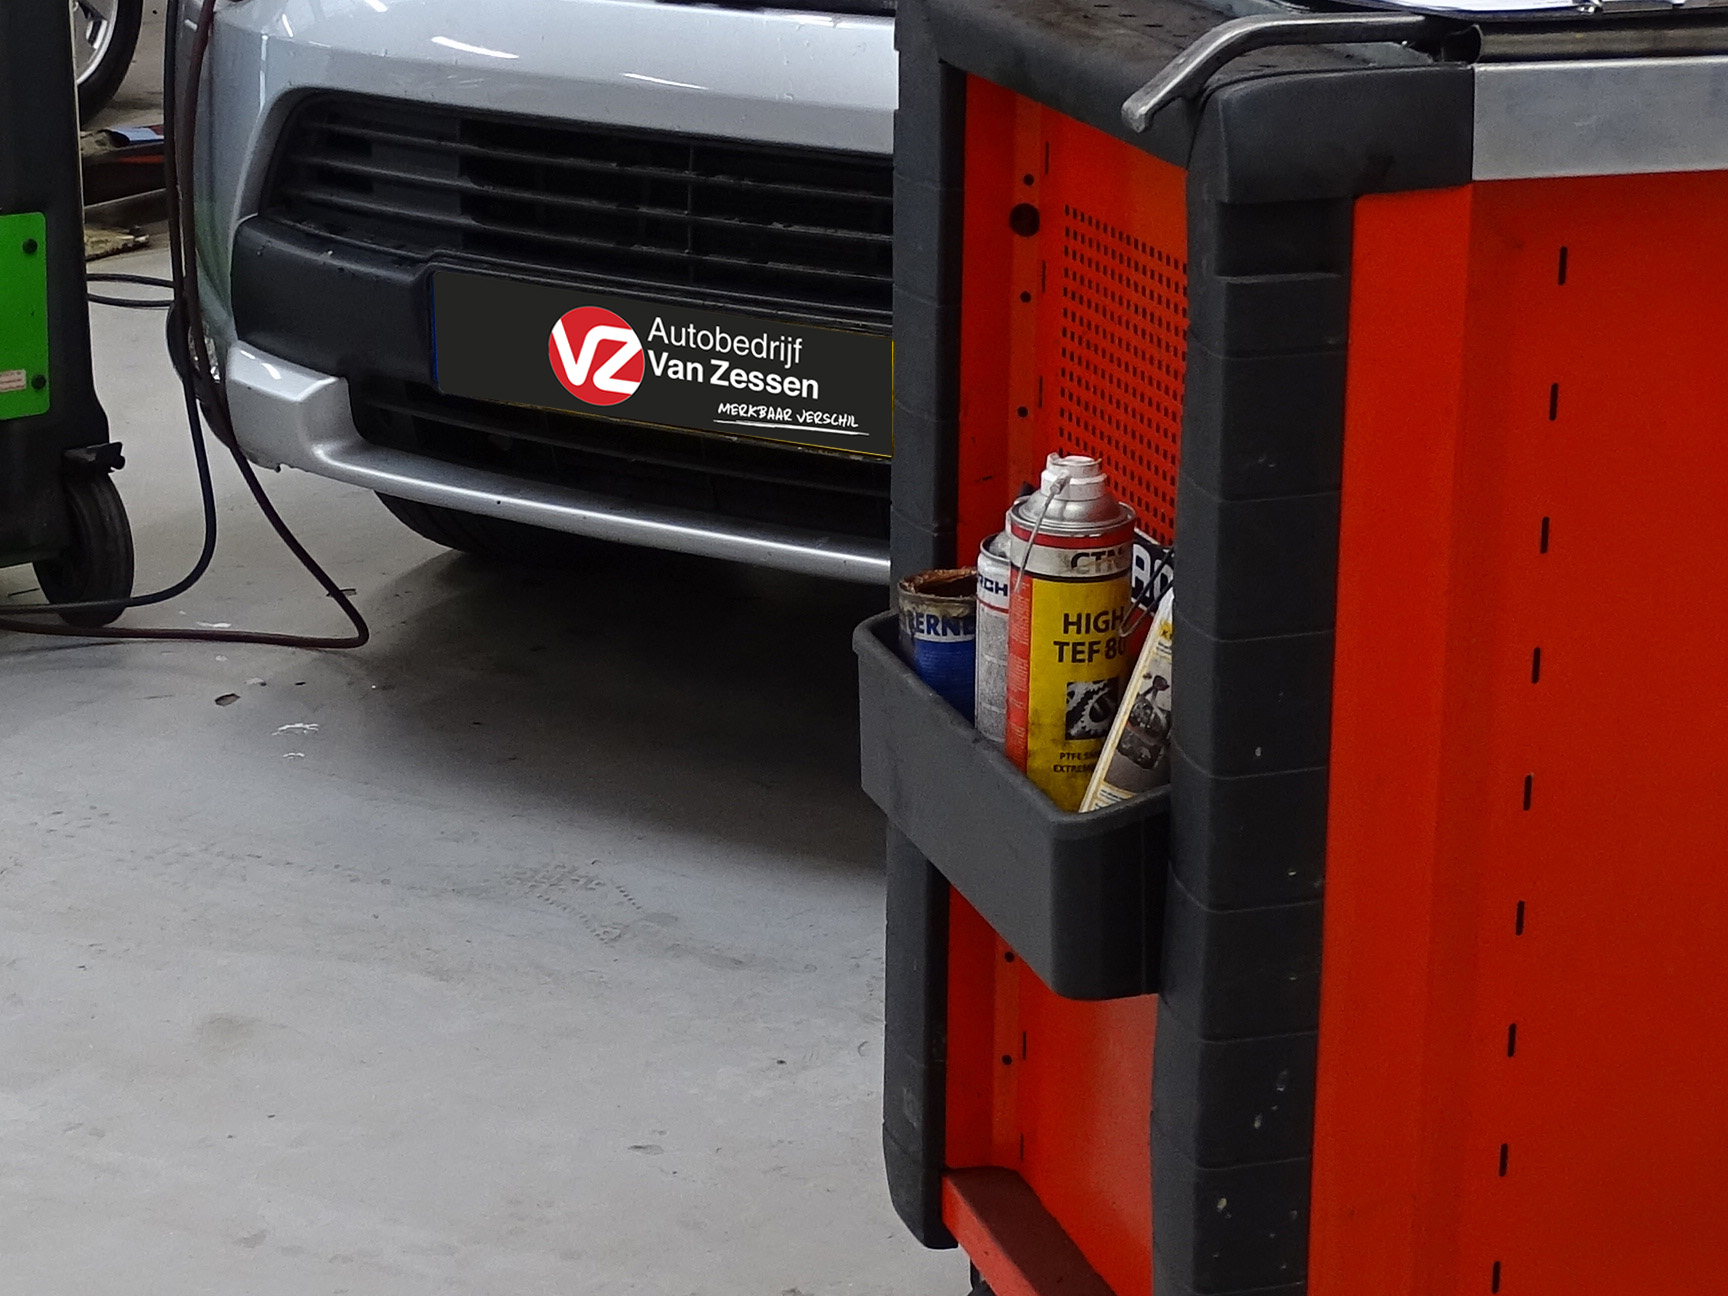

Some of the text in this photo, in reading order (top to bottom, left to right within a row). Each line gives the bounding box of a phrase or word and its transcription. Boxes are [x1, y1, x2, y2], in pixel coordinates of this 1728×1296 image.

[1063, 605, 1125, 635] HIGH
[1053, 636, 1127, 664] TEF 80
